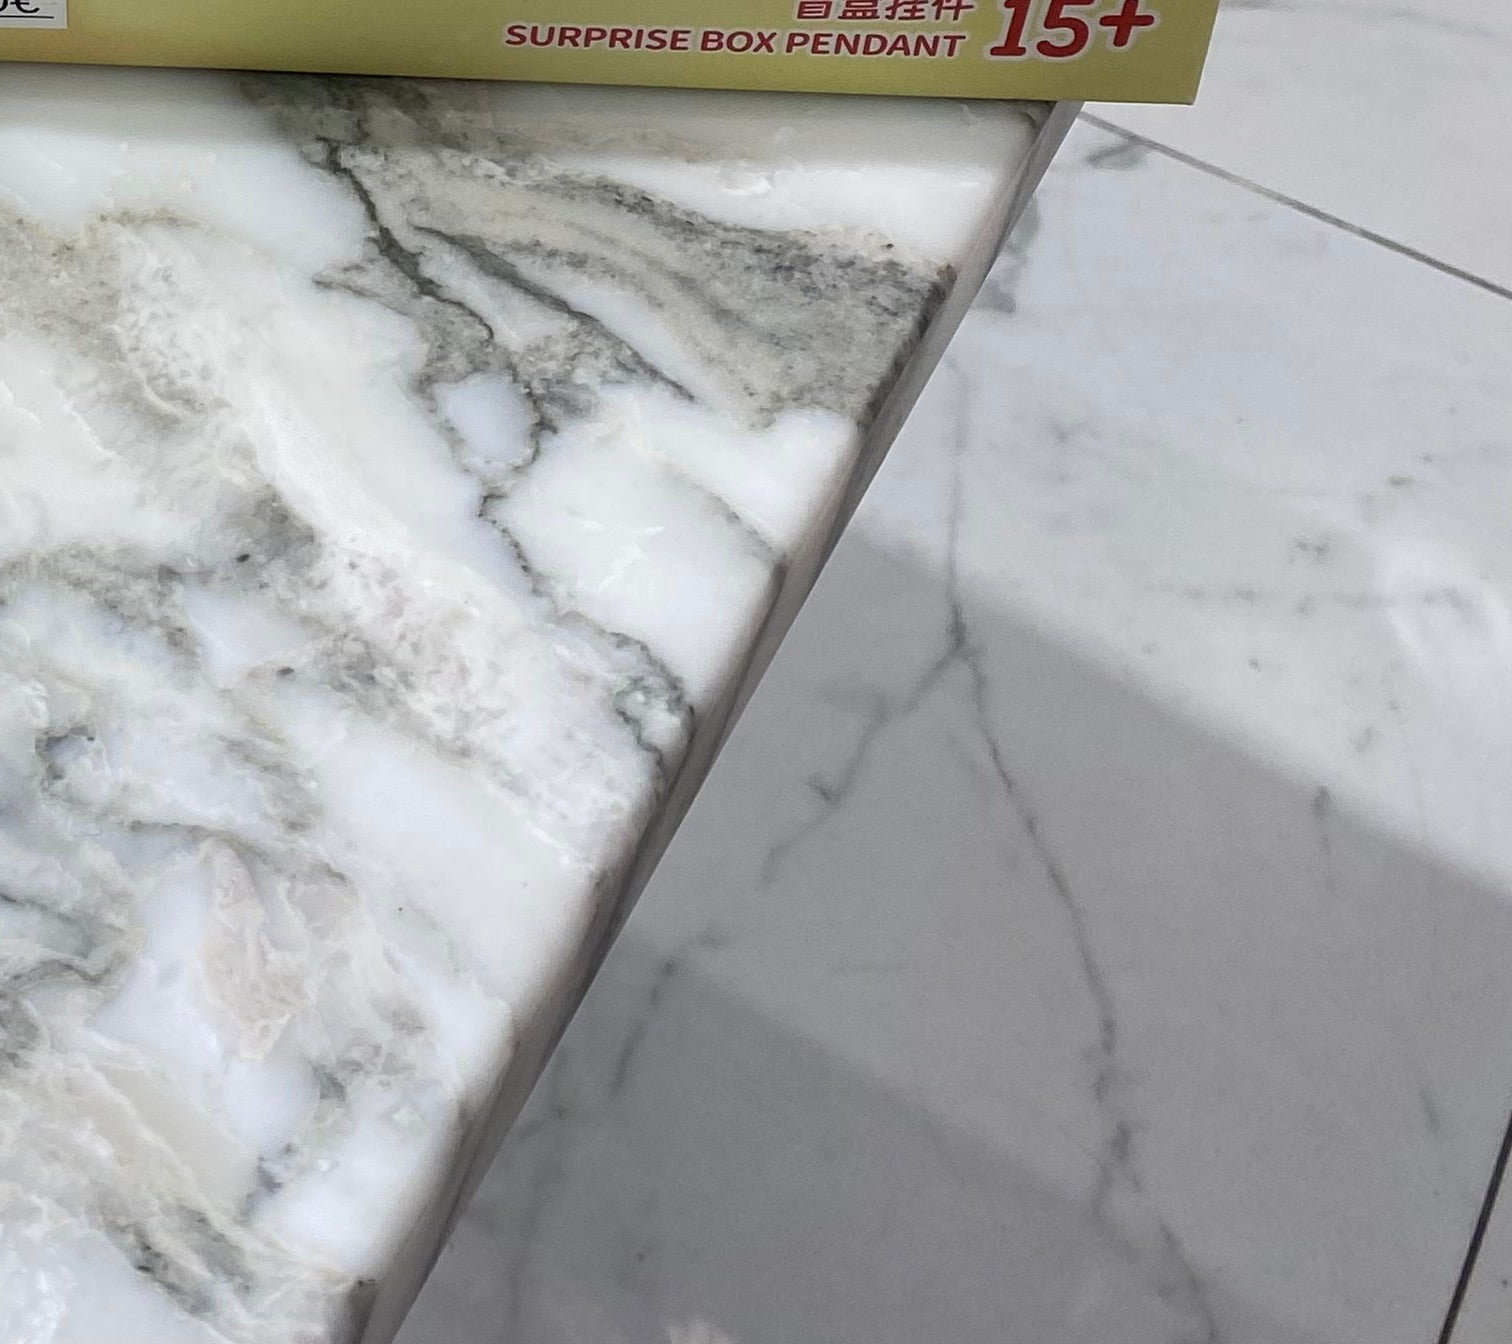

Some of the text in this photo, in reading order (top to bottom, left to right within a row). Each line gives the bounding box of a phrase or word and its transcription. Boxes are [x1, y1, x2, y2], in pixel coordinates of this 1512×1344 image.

[505, 24, 966, 58] SURPRISE BOX PENDANT
